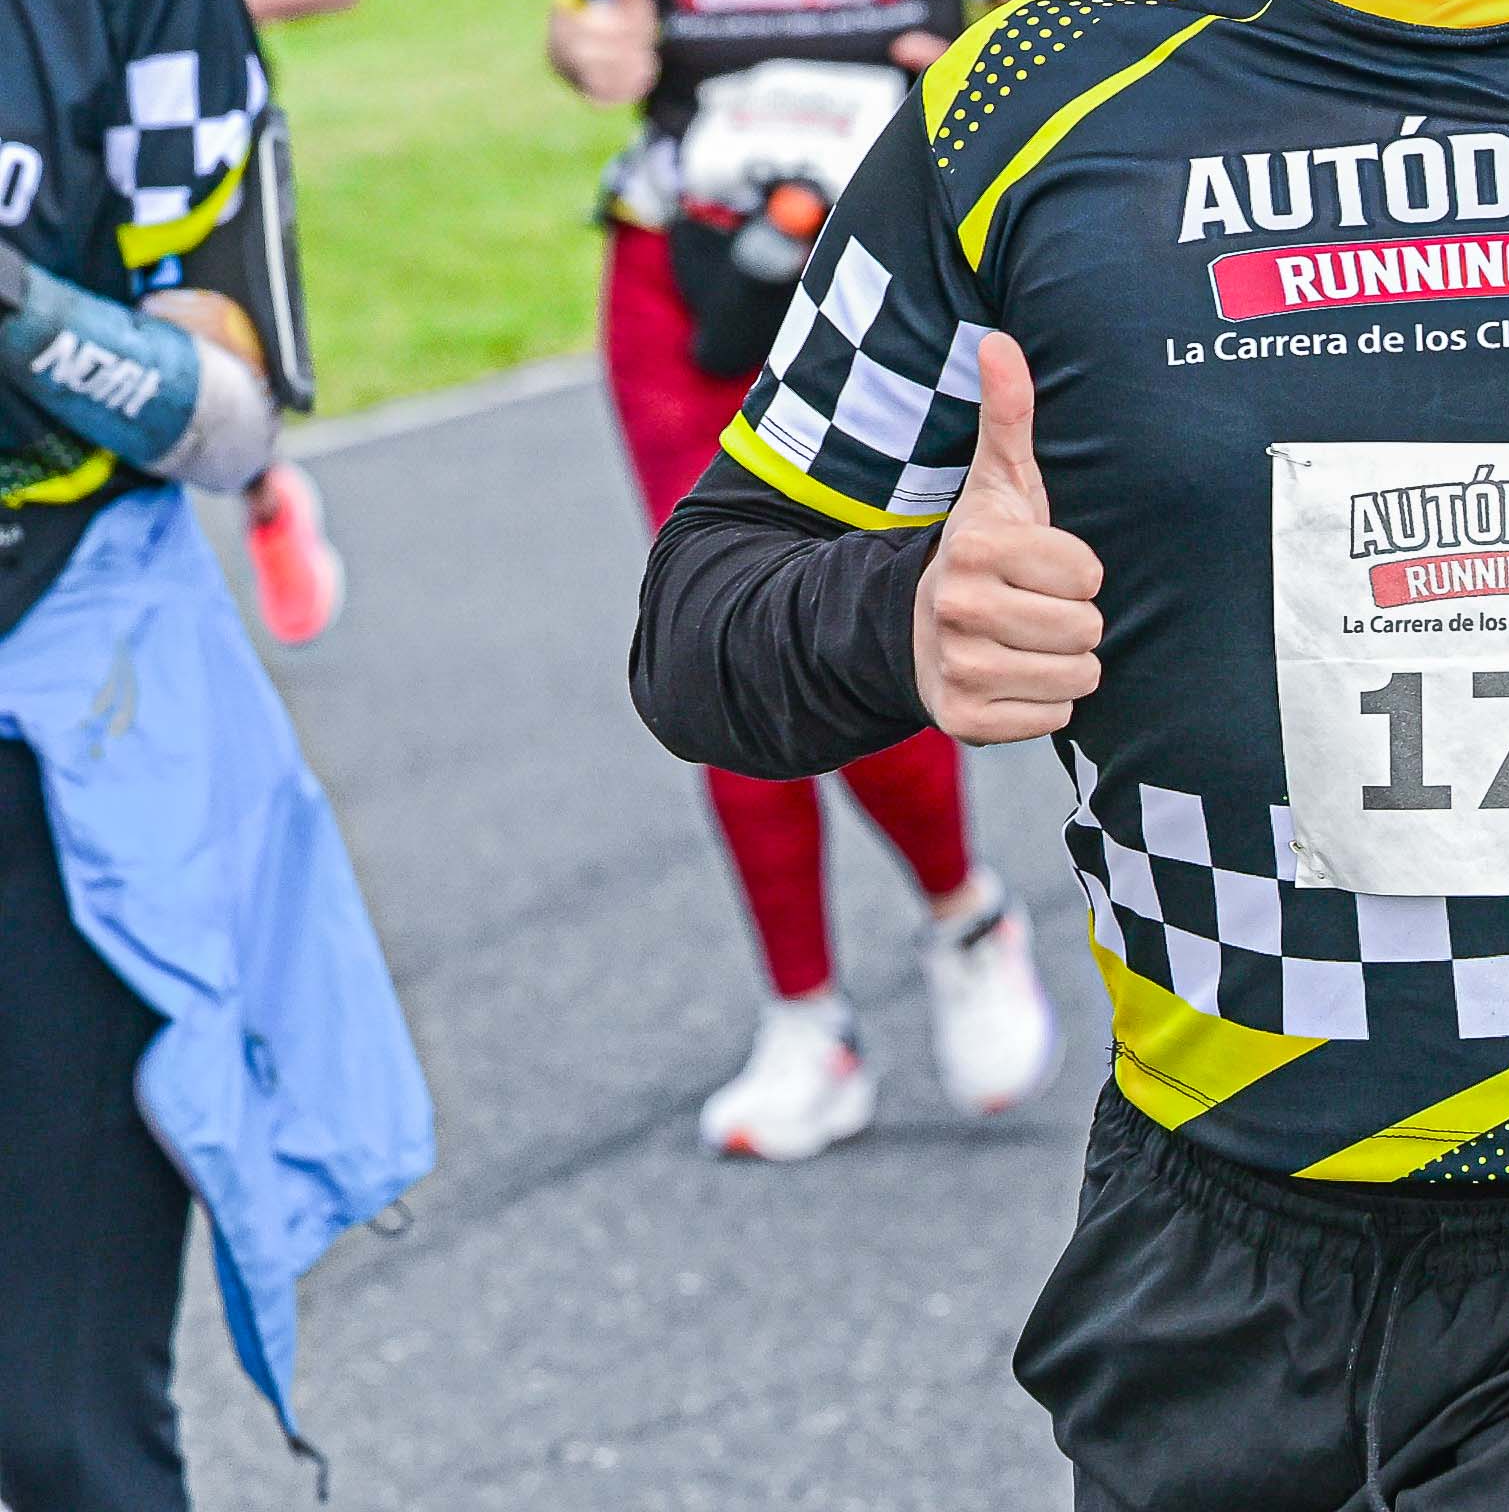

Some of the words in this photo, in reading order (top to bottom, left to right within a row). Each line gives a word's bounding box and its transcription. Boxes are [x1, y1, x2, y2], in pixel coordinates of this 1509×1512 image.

[1166, 338, 1205, 367] La
[1213, 332, 1348, 361] Carrera
[1357, 324, 1405, 354] de
[1414, 323, 1467, 352] los
[1342, 615, 1365, 634] La
[1370, 615, 1443, 634] Carrera
[1449, 612, 1474, 632] de
[1479, 611, 1508, 632] los
